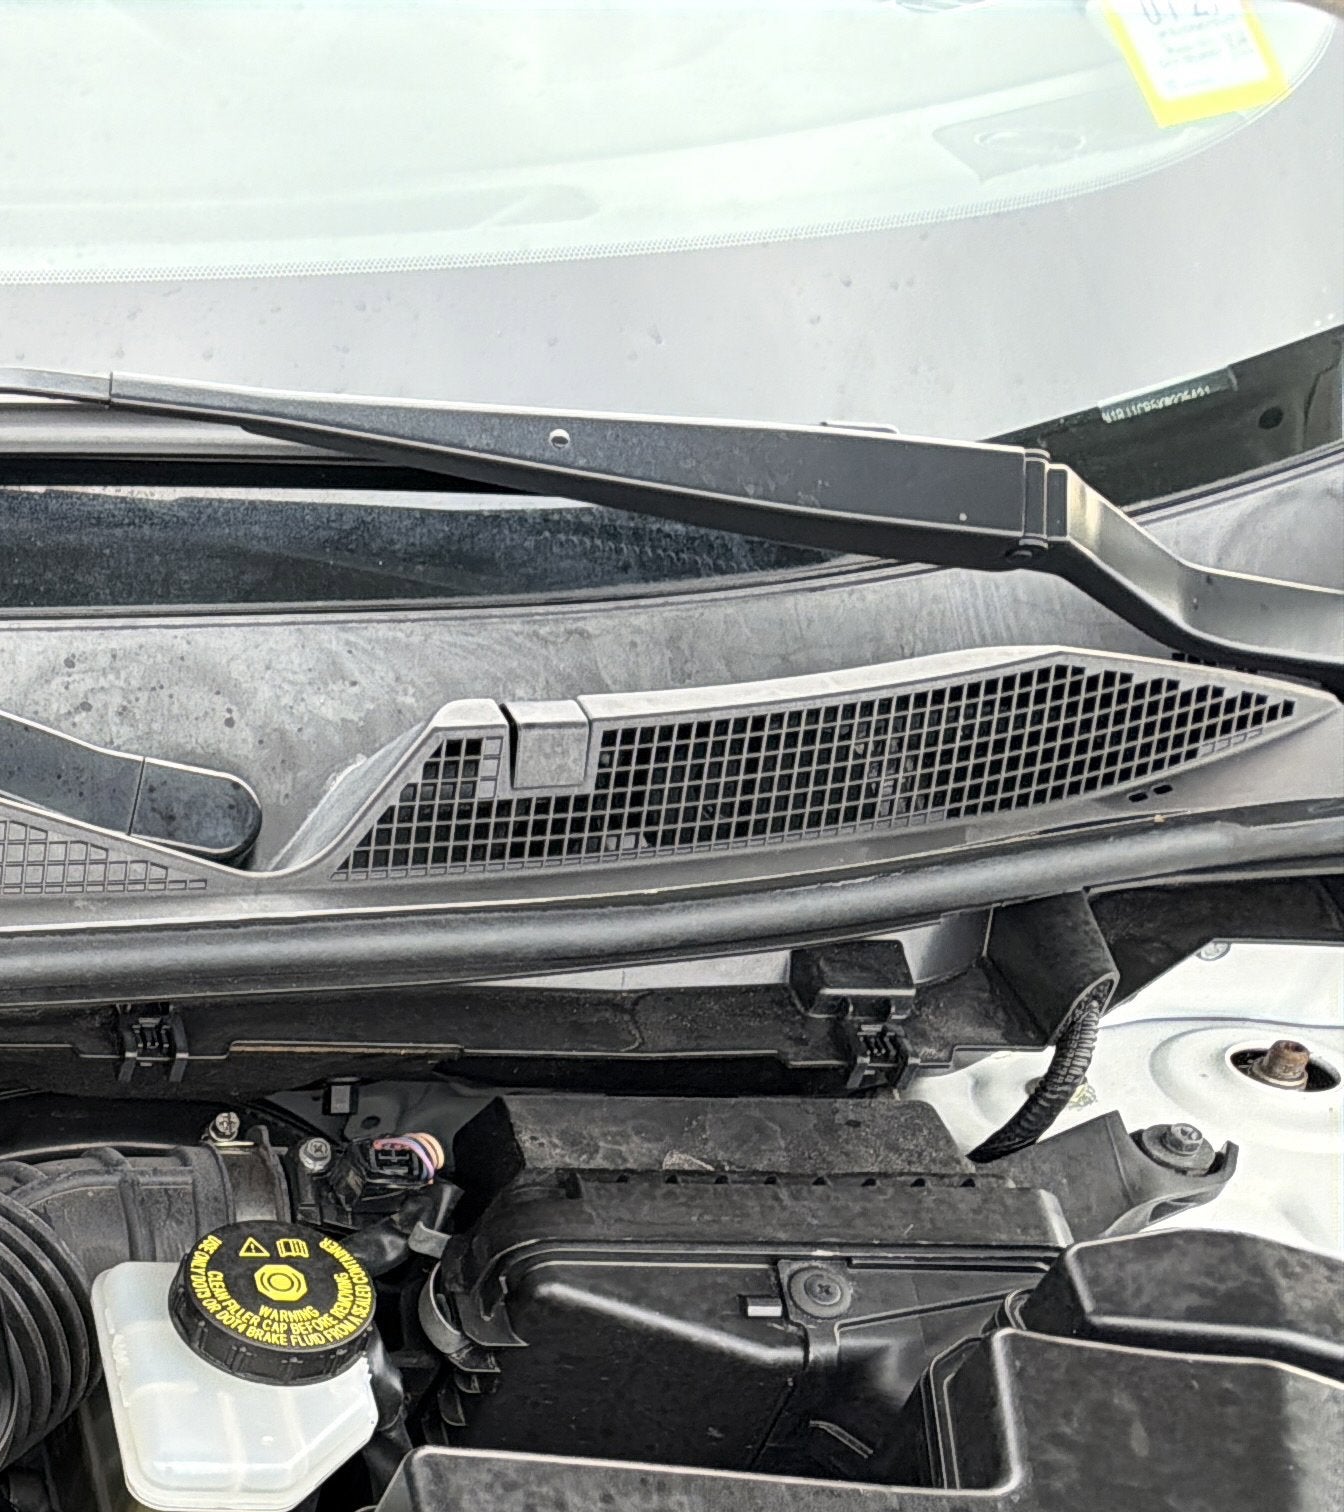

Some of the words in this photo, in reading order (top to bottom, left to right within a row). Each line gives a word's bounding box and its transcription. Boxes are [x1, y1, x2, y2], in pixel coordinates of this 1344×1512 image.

[198, 1235, 223, 1255] USE
[191, 1250, 210, 1275] ONLY
[319, 1237, 369, 1284] CONTAINER
[191, 1275, 212, 1299] DOT3
[202, 1298, 222, 1313] OR
[207, 1270, 231, 1301] CLEAN
[222, 1299, 260, 1327] FILLER
[262, 1319, 288, 1334] CAP
[289, 1313, 338, 1335] BEFORE
[329, 1272, 354, 1320] REMOVING
[351, 1284, 372, 1318] SEALED
[215, 1310, 248, 1333] DOT4
[259, 1305, 320, 1322] WARNING
[347, 1315, 364, 1327] A
[246, 1326, 288, 1346] BRAKE
[290, 1333, 326, 1347] FLUID
[323, 1320, 357, 1343] FROM
